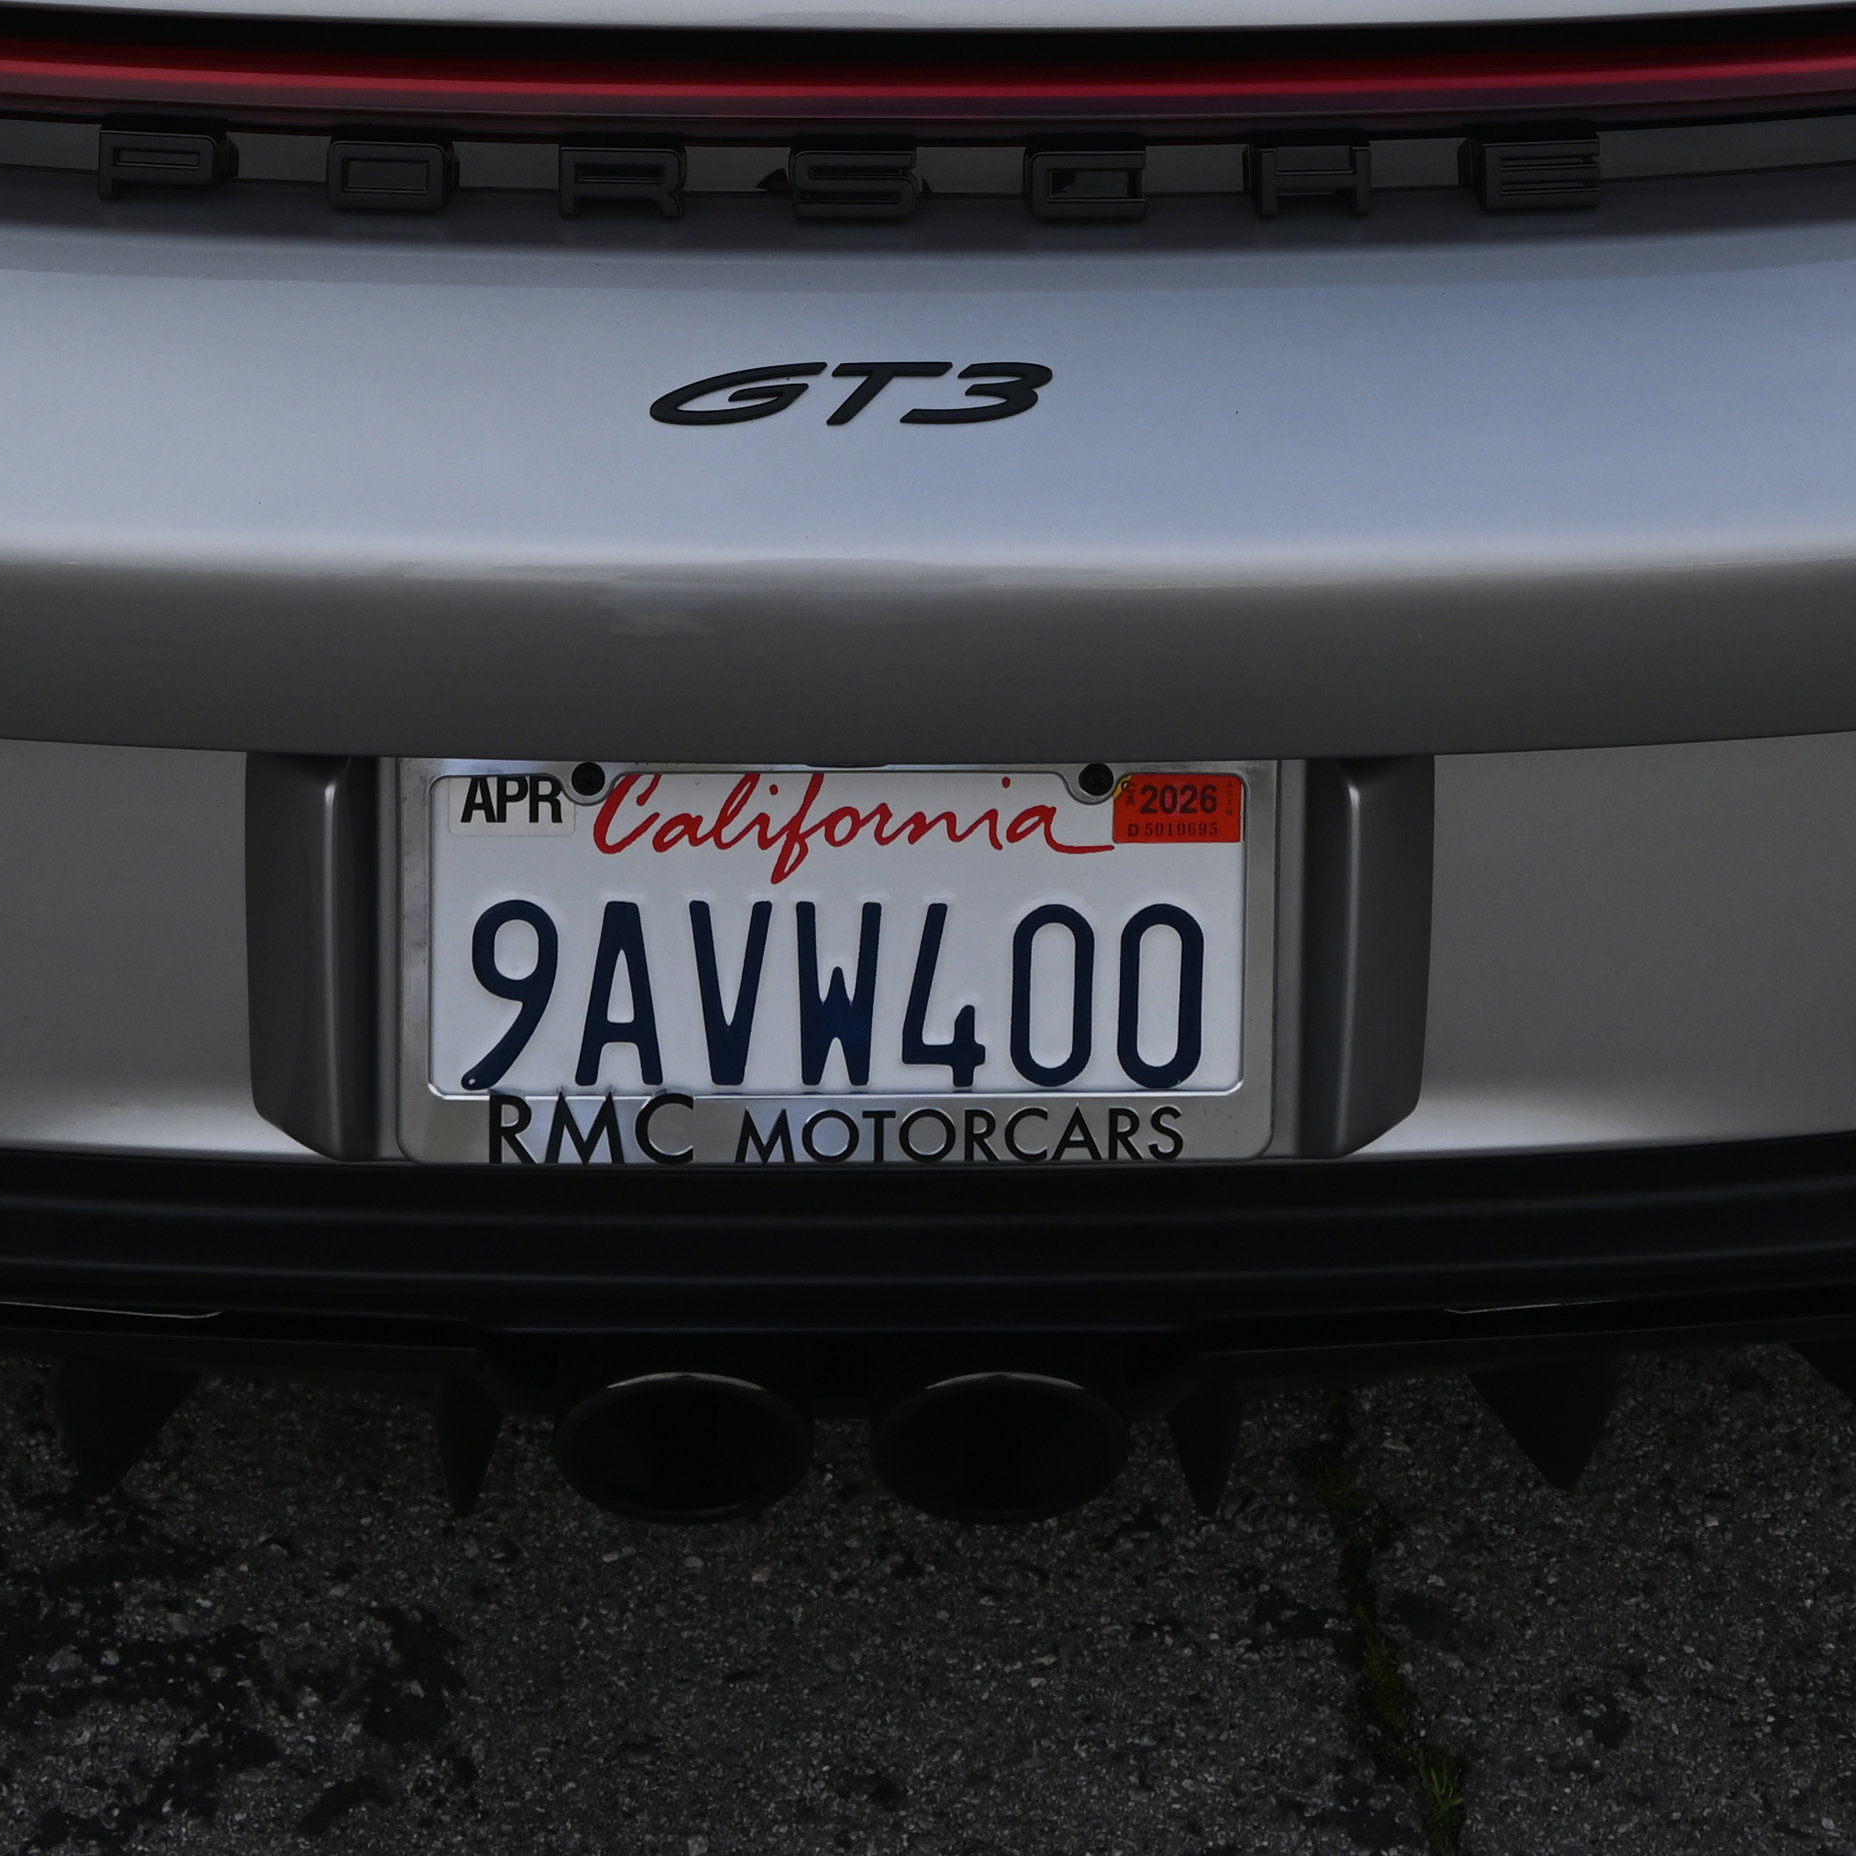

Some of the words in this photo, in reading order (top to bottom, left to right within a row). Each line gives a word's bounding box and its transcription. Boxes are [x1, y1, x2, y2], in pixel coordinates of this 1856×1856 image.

[97, 129, 1601, 219] PORSCHE
[649, 361, 1053, 426] GT3
[460, 775, 564, 824] APR
[592, 773, 1115, 885] California
[1139, 784, 1219, 815] 2026
[459, 899, 1206, 1091] 9AVW400
[489, 1092, 695, 1165] RMC
[734, 1105, 1184, 1164] MOTORCARS
